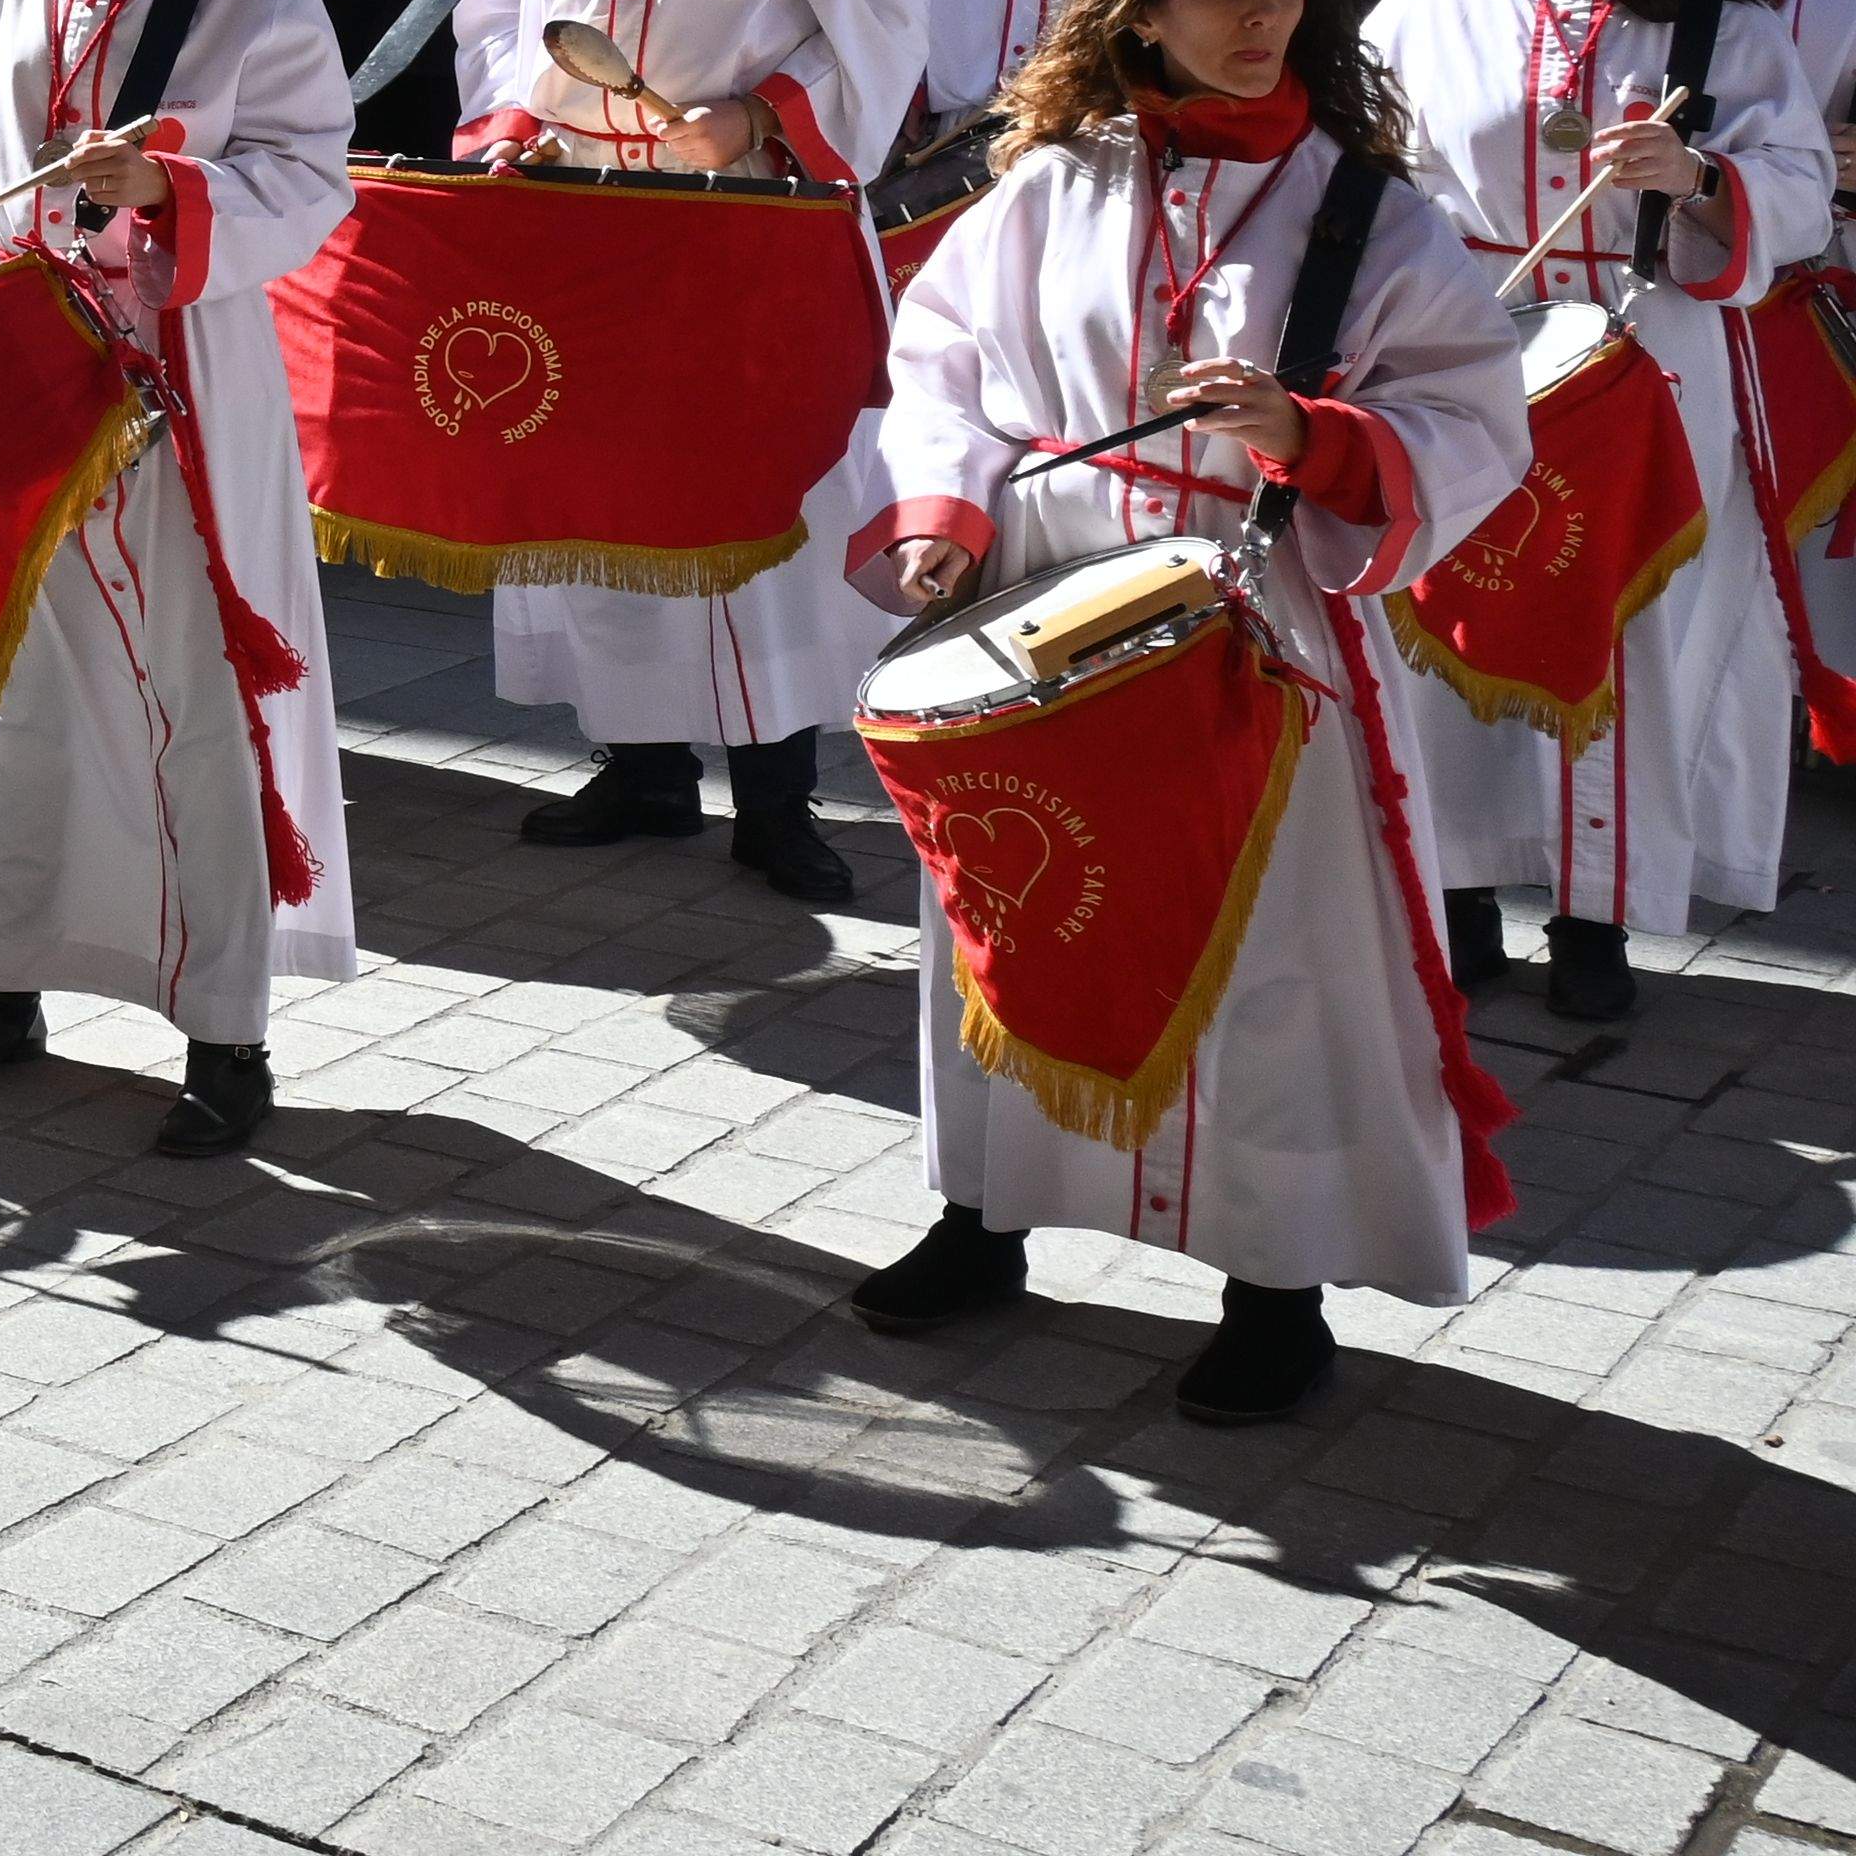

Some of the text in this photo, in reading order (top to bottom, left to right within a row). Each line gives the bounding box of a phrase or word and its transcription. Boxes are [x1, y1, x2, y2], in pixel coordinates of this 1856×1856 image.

[413, 300, 563, 445] COFRADIA DE LA PRECIOSISIMA SANGRE
[1544, 511, 1585, 578] SANGRE
[935, 771, 1096, 849] PRECIOSISIMA
[1053, 864, 1106, 944] SANGRE
